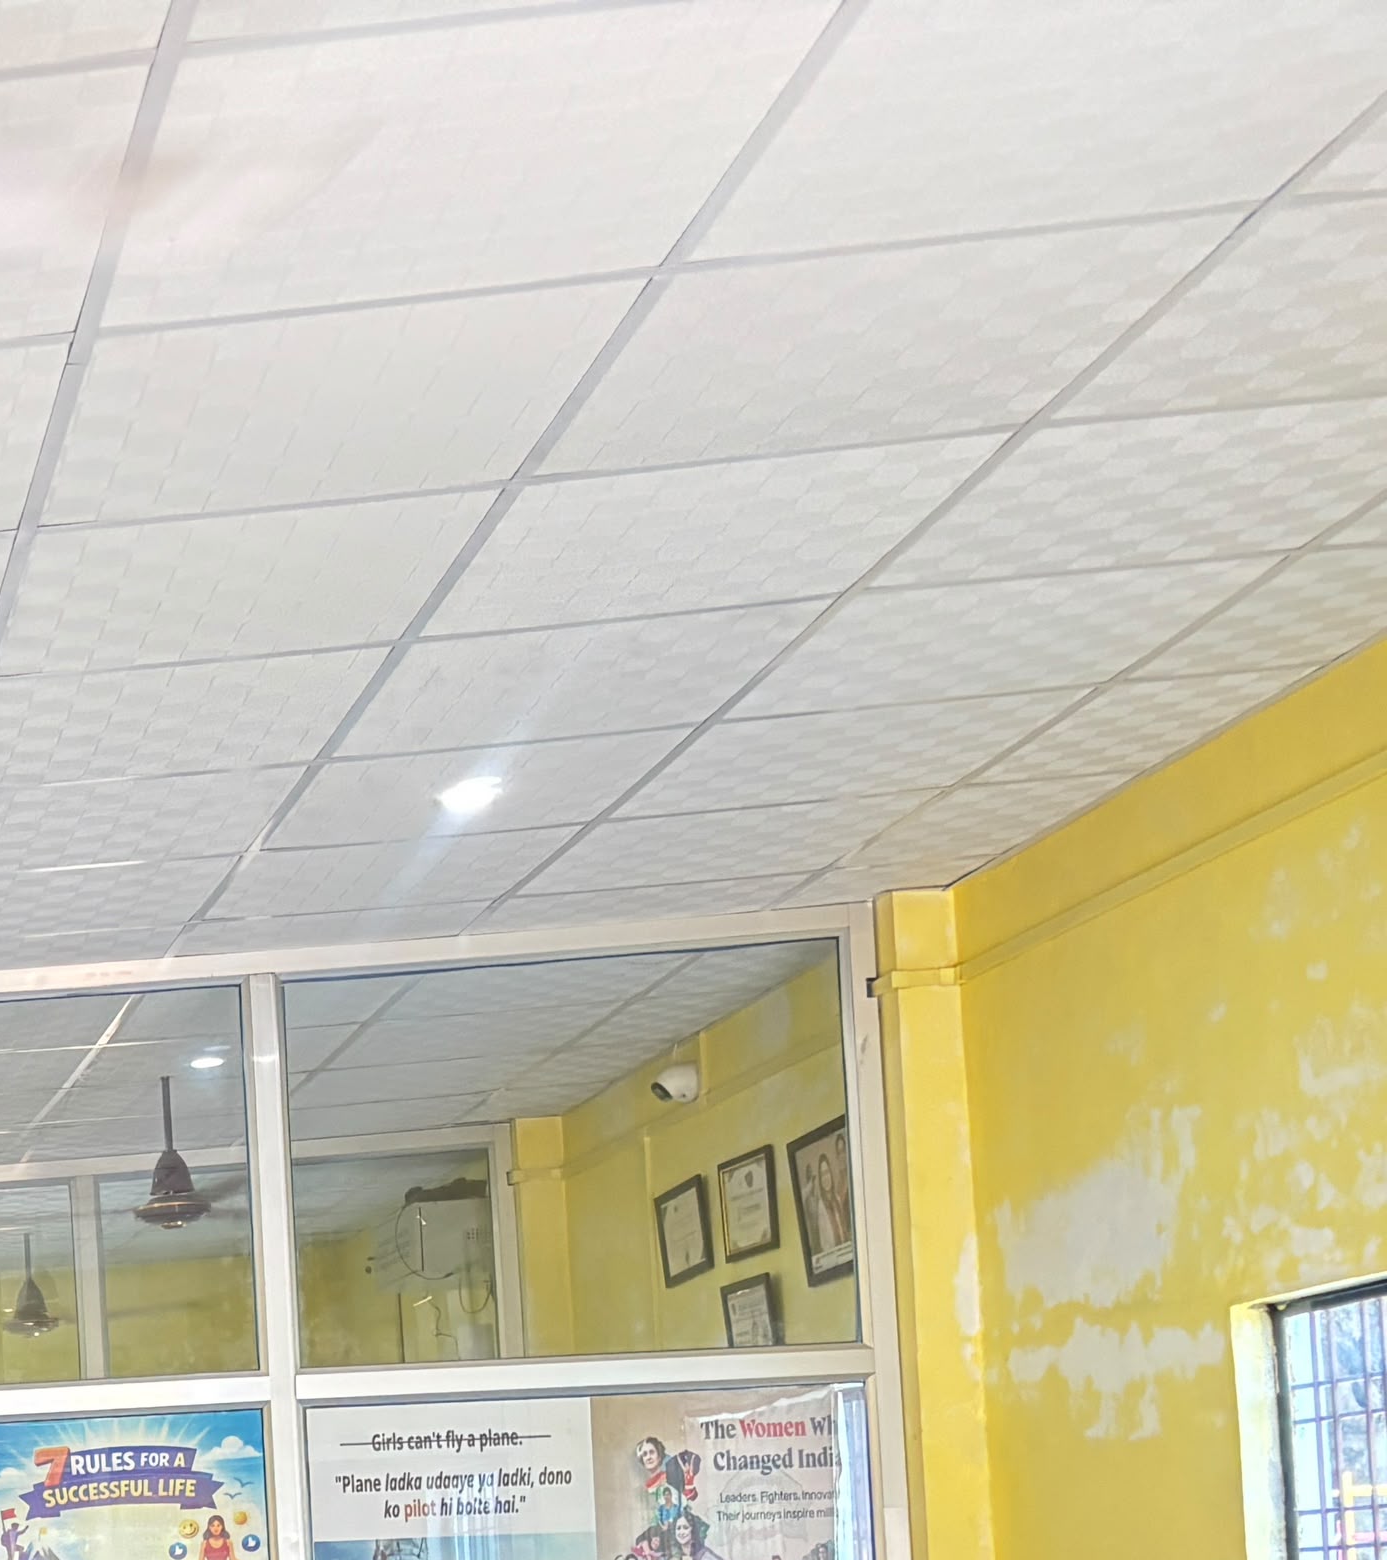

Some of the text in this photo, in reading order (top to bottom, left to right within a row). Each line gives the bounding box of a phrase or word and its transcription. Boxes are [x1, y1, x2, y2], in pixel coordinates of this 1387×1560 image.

[371, 1429, 523, 1452] Girls can't fly a plane.
[700, 1420, 737, 1440] The
[739, 1419, 807, 1439] Women
[34, 1446, 186, 1487] 7 RULES FOR A
[713, 1448, 794, 1475] Changed
[335, 1466, 572, 1494] "Plane ladka udaaye ya ladki, dono
[42, 1479, 197, 1508] SUCCESSFUL LIFE
[384, 1500, 400, 1518] ko
[404, 1499, 437, 1522] pilot
[440, 1497, 453, 1516] hi
[494, 1496, 526, 1514] hai."
[717, 1511, 740, 1522] Their
